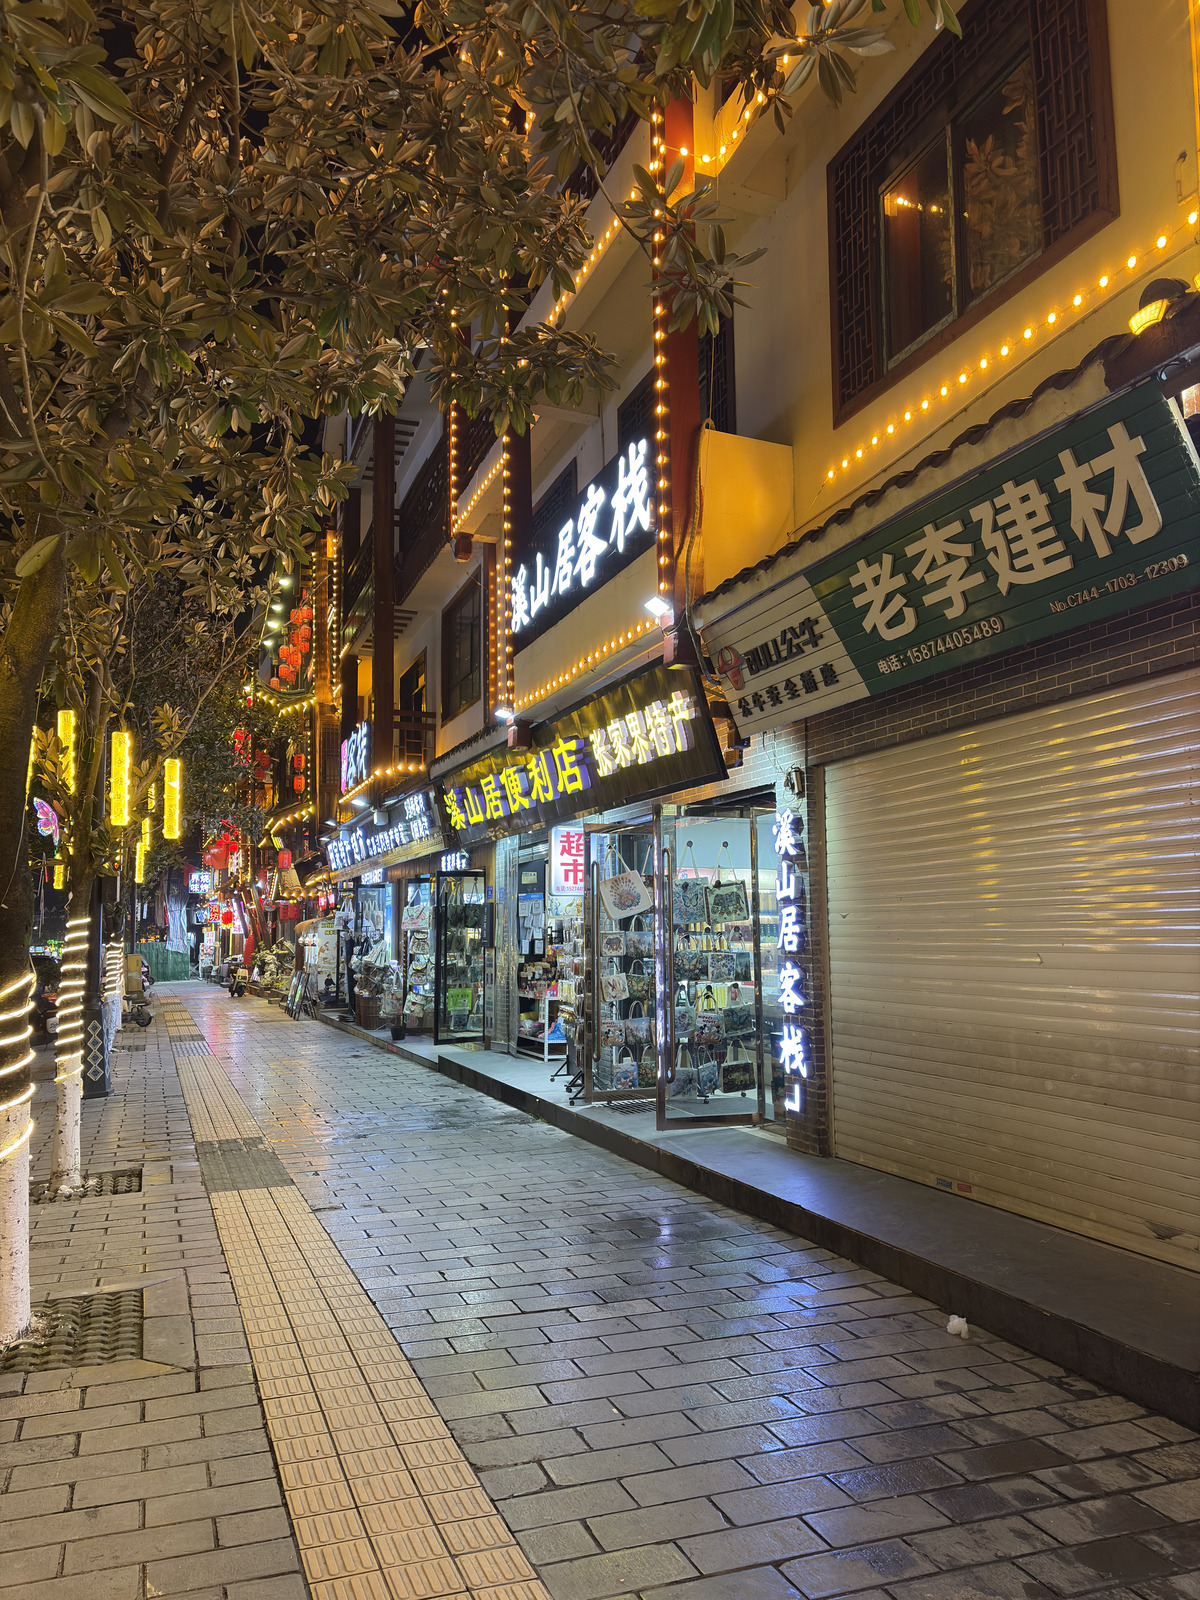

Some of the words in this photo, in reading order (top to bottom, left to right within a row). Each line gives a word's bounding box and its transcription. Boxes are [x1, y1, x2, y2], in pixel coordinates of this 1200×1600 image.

[511, 439, 651, 632] 溪山居客栈
[848, 421, 1163, 642] 老李建材
[589, 690, 694, 778] 张家界特产
[738, 663, 839, 718] 公牛安全插座
[444, 738, 582, 832] 溪山居便利店
[559, 831, 584, 885] 超市
[772, 808, 807, 1079] 溪山居客栈
